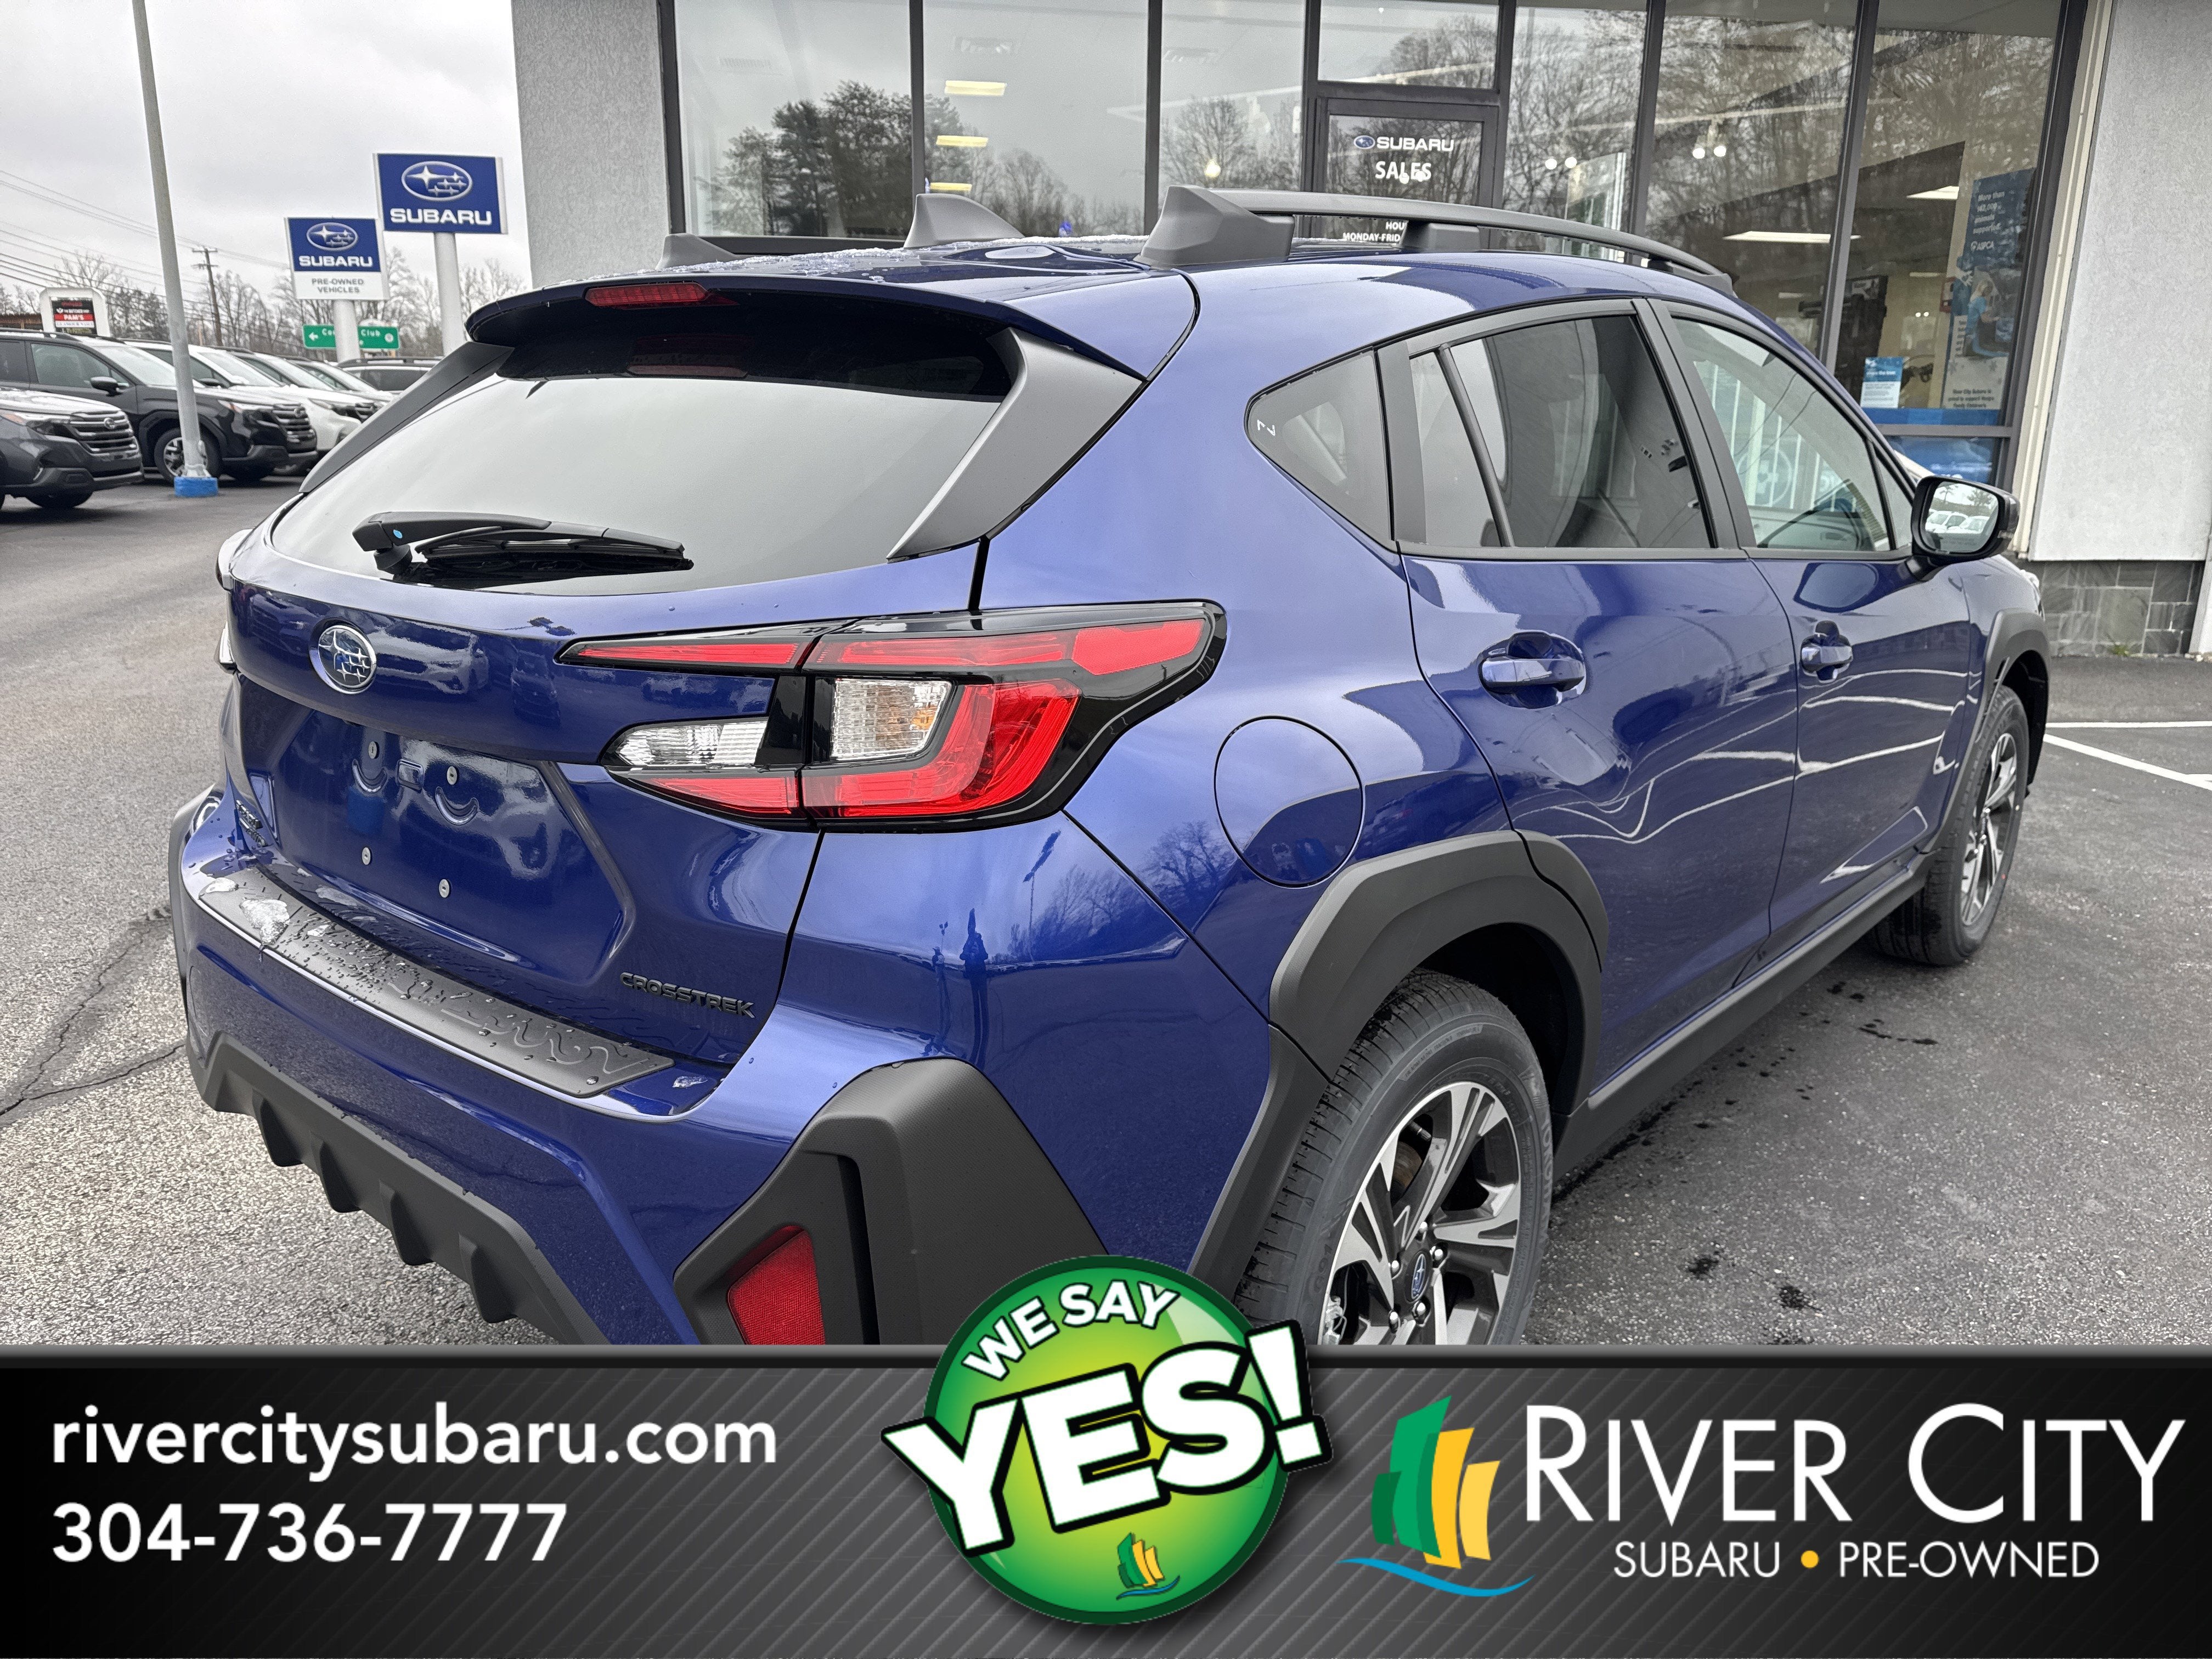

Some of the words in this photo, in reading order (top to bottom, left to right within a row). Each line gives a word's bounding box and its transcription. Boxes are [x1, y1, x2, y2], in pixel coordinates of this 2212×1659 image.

[1376, 137, 1454, 151] SUBARU
[1375, 161, 1432, 180] SALES
[390, 208, 492, 225] SUBARU
[1385, 221, 1407, 230] HOU
[1342, 232, 1401, 242] MONDAY-FRID
[298, 255, 373, 268] SUBARU
[360, 329, 381, 337] Club
[620, 972, 755, 1019] CROSSTREK
